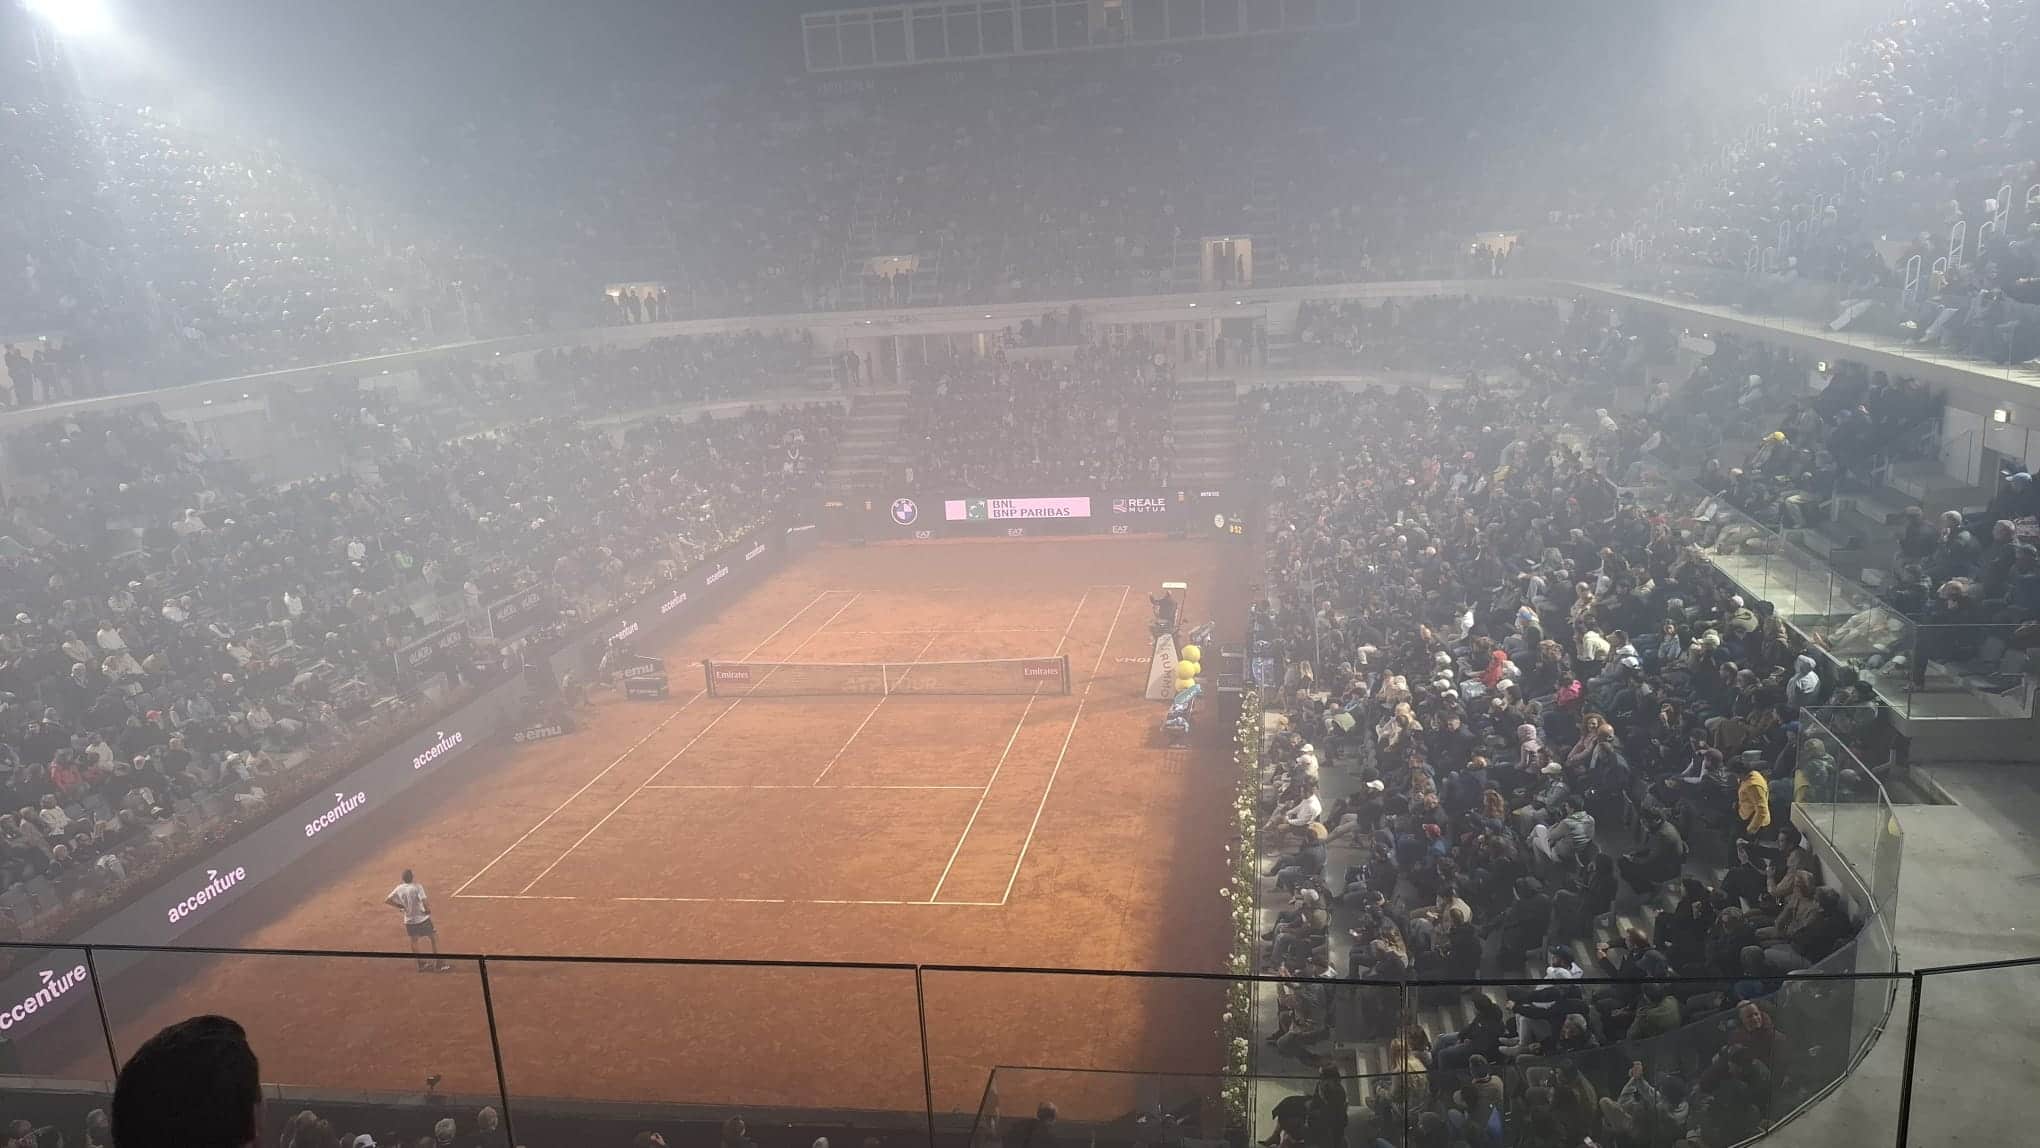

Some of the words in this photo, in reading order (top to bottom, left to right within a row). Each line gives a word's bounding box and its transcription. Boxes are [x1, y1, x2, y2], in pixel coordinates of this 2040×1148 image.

[993, 500, 1014, 508] BNL
[993, 509, 1018, 517] BNP
[1021, 507, 1070, 517] PARIBAS
[1129, 498, 1165, 506] REALE
[526, 725, 562, 741] emu
[413, 730, 463, 769] accenture
[304, 789, 367, 838] accenture
[168, 864, 246, 923] accenture
[0, 965, 87, 1029] ccenture
